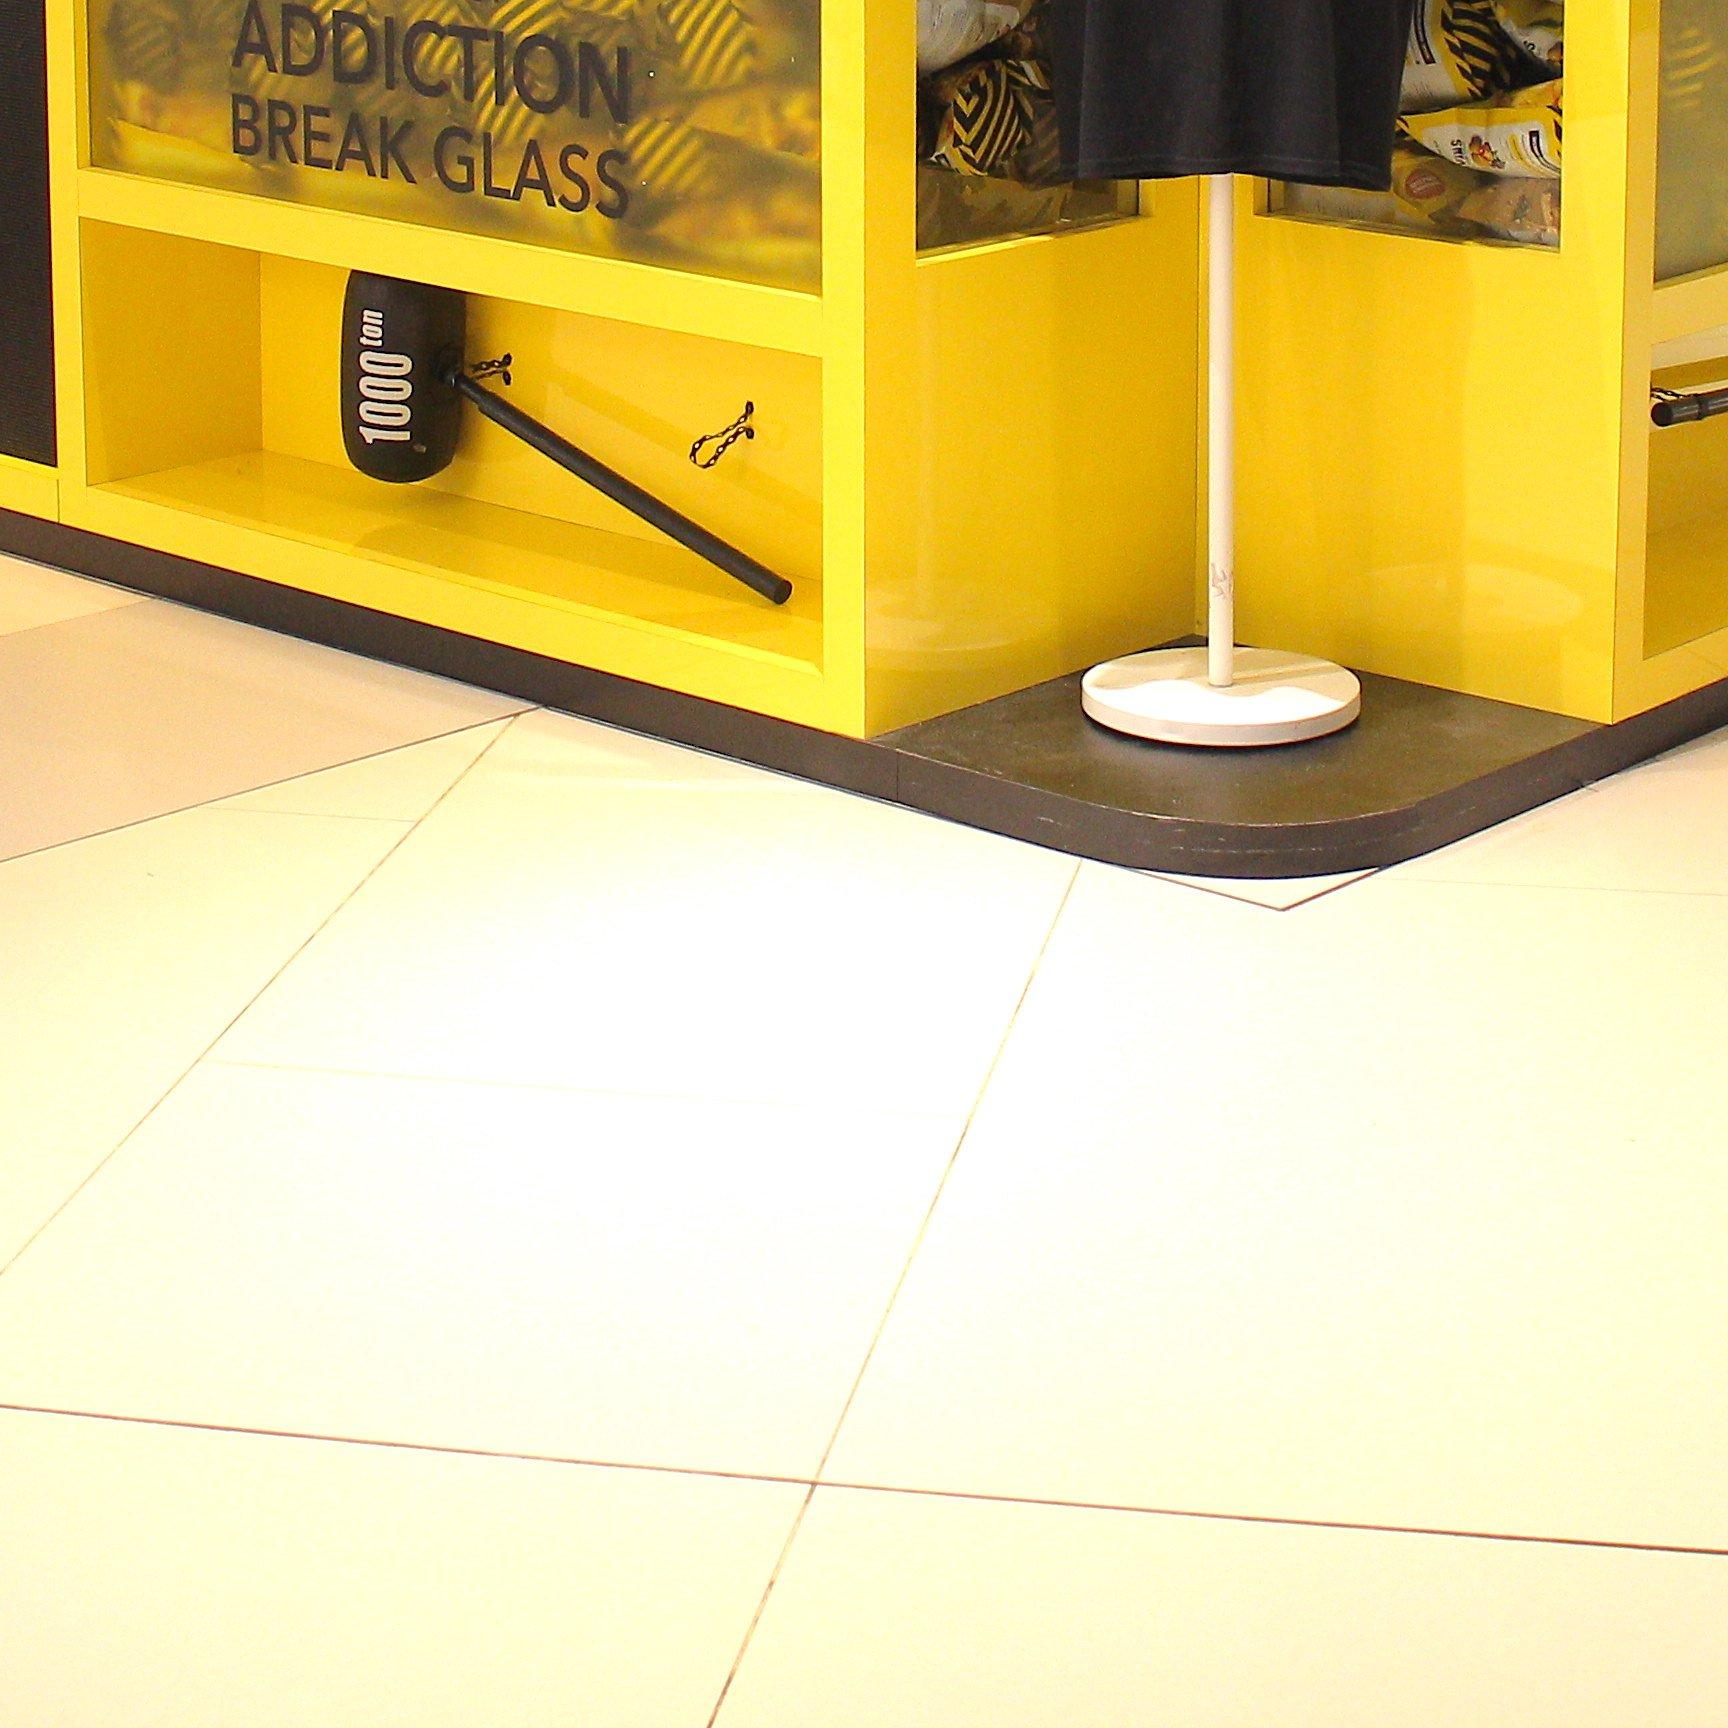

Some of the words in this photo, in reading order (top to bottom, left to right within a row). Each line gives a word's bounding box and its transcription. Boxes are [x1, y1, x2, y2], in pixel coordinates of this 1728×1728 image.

[231, 93, 419, 185] BREAK
[432, 124, 630, 219] GLASS
[359, 308, 384, 347] ton
[357, 350, 414, 444] 1000
